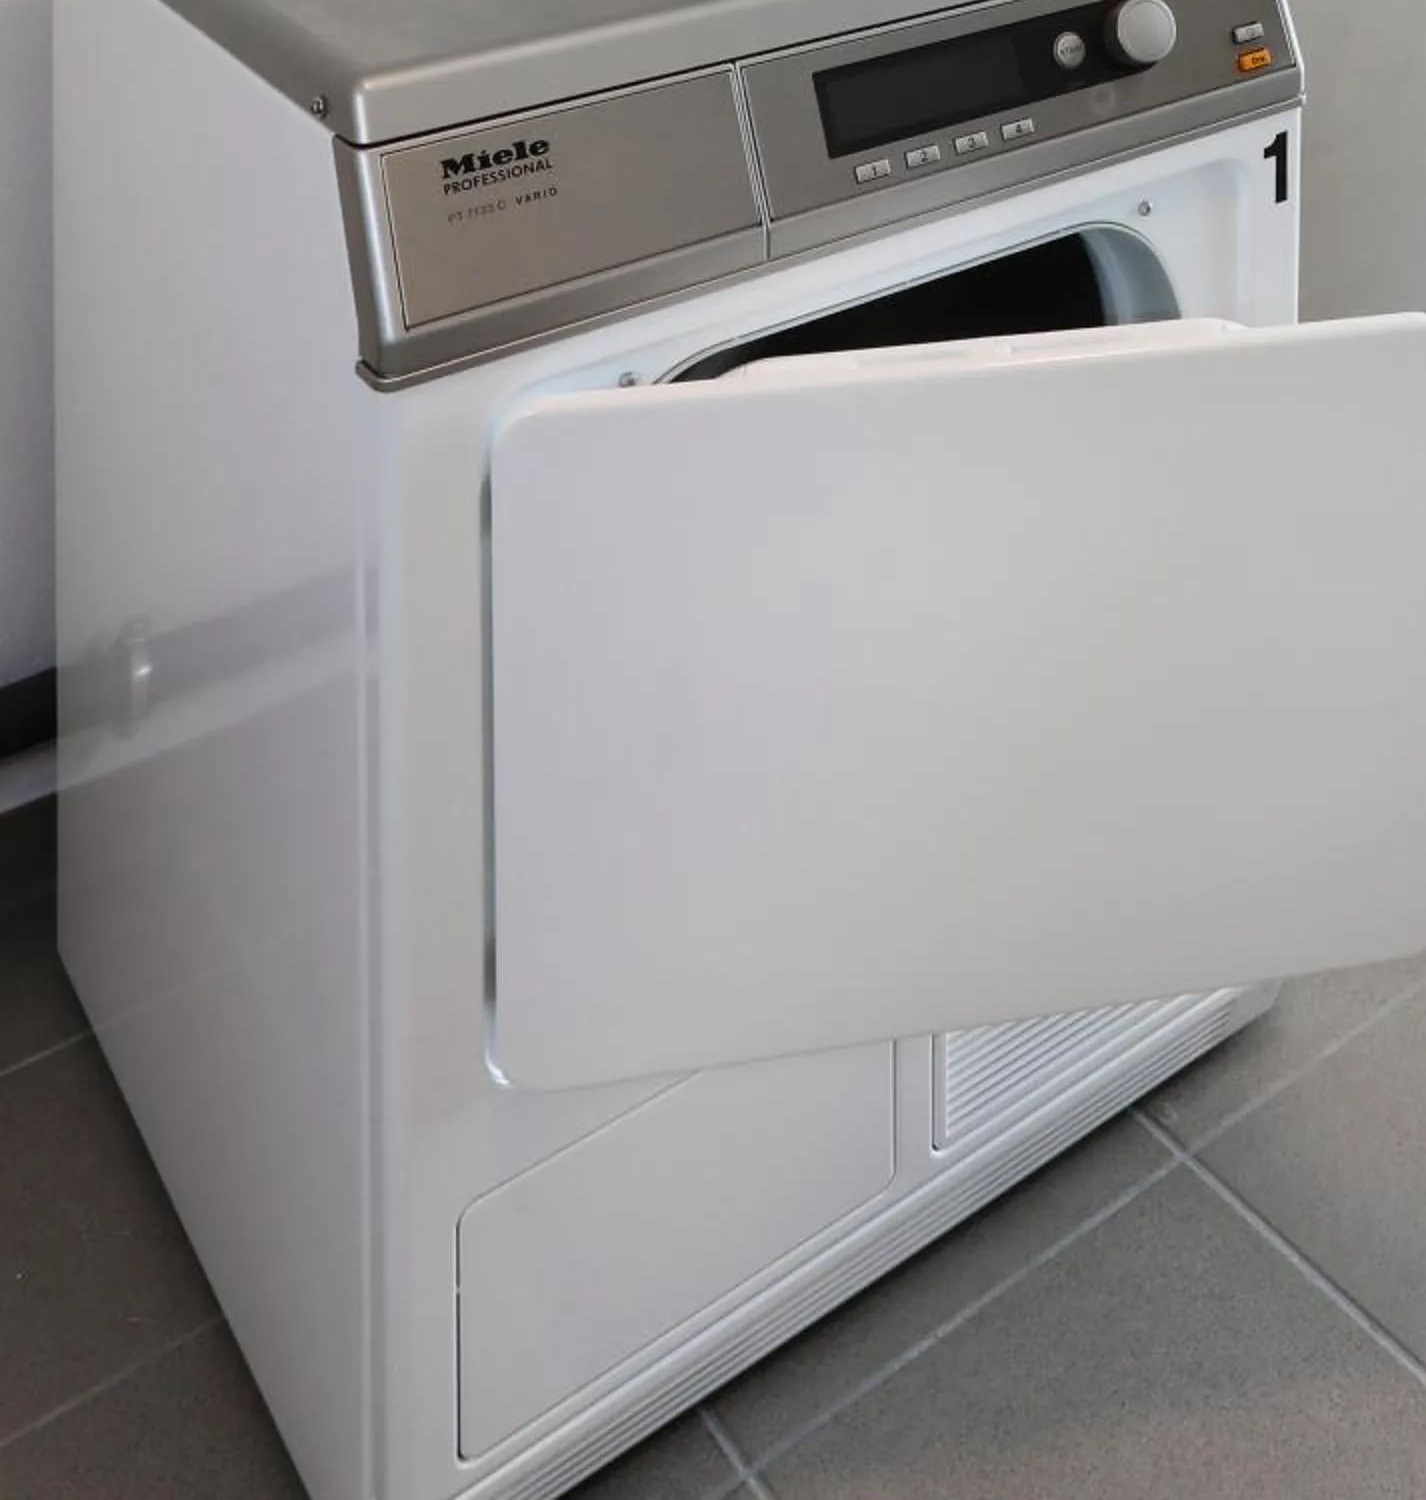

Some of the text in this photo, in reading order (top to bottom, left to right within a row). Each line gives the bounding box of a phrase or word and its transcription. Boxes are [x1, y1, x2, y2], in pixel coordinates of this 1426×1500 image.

[440, 139, 550, 179] Miele
[443, 158, 552, 195] PROFESSIONAL
[1263, 130, 1288, 204] 1
